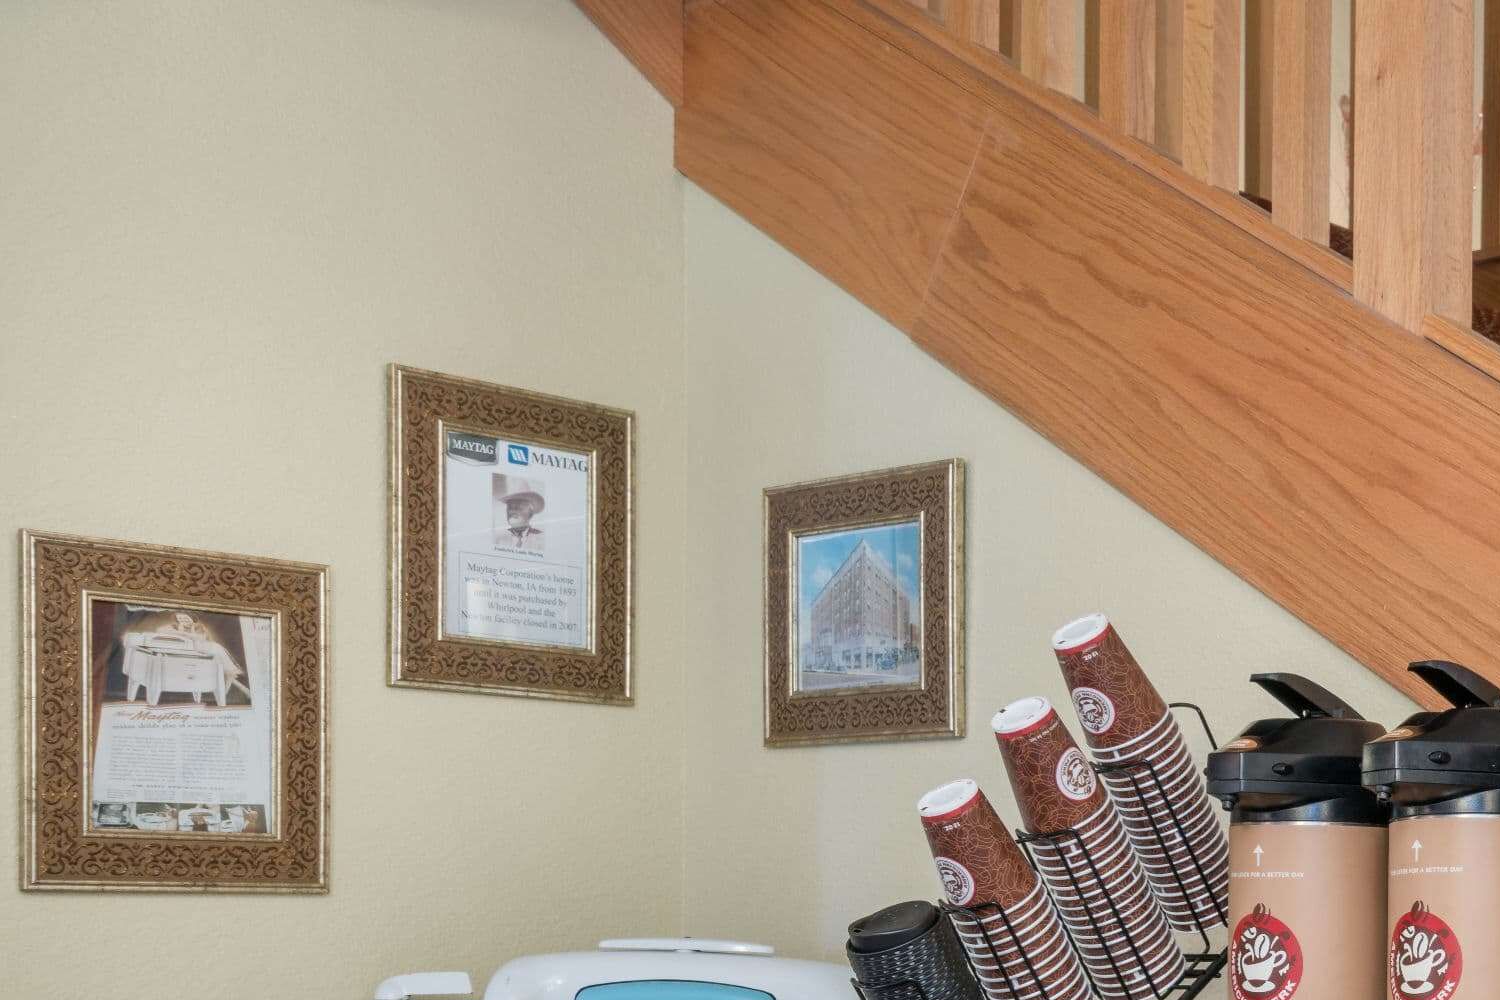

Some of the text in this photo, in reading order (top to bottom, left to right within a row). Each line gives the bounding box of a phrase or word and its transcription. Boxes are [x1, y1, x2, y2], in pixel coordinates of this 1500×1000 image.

[452, 438, 497, 455] MAYTAG
[532, 452, 589, 473] MAYTAG
[467, 561, 498, 576] Maytag
[538, 584, 556, 594] from
[527, 607, 543, 616] and
[543, 608, 556, 618] the
